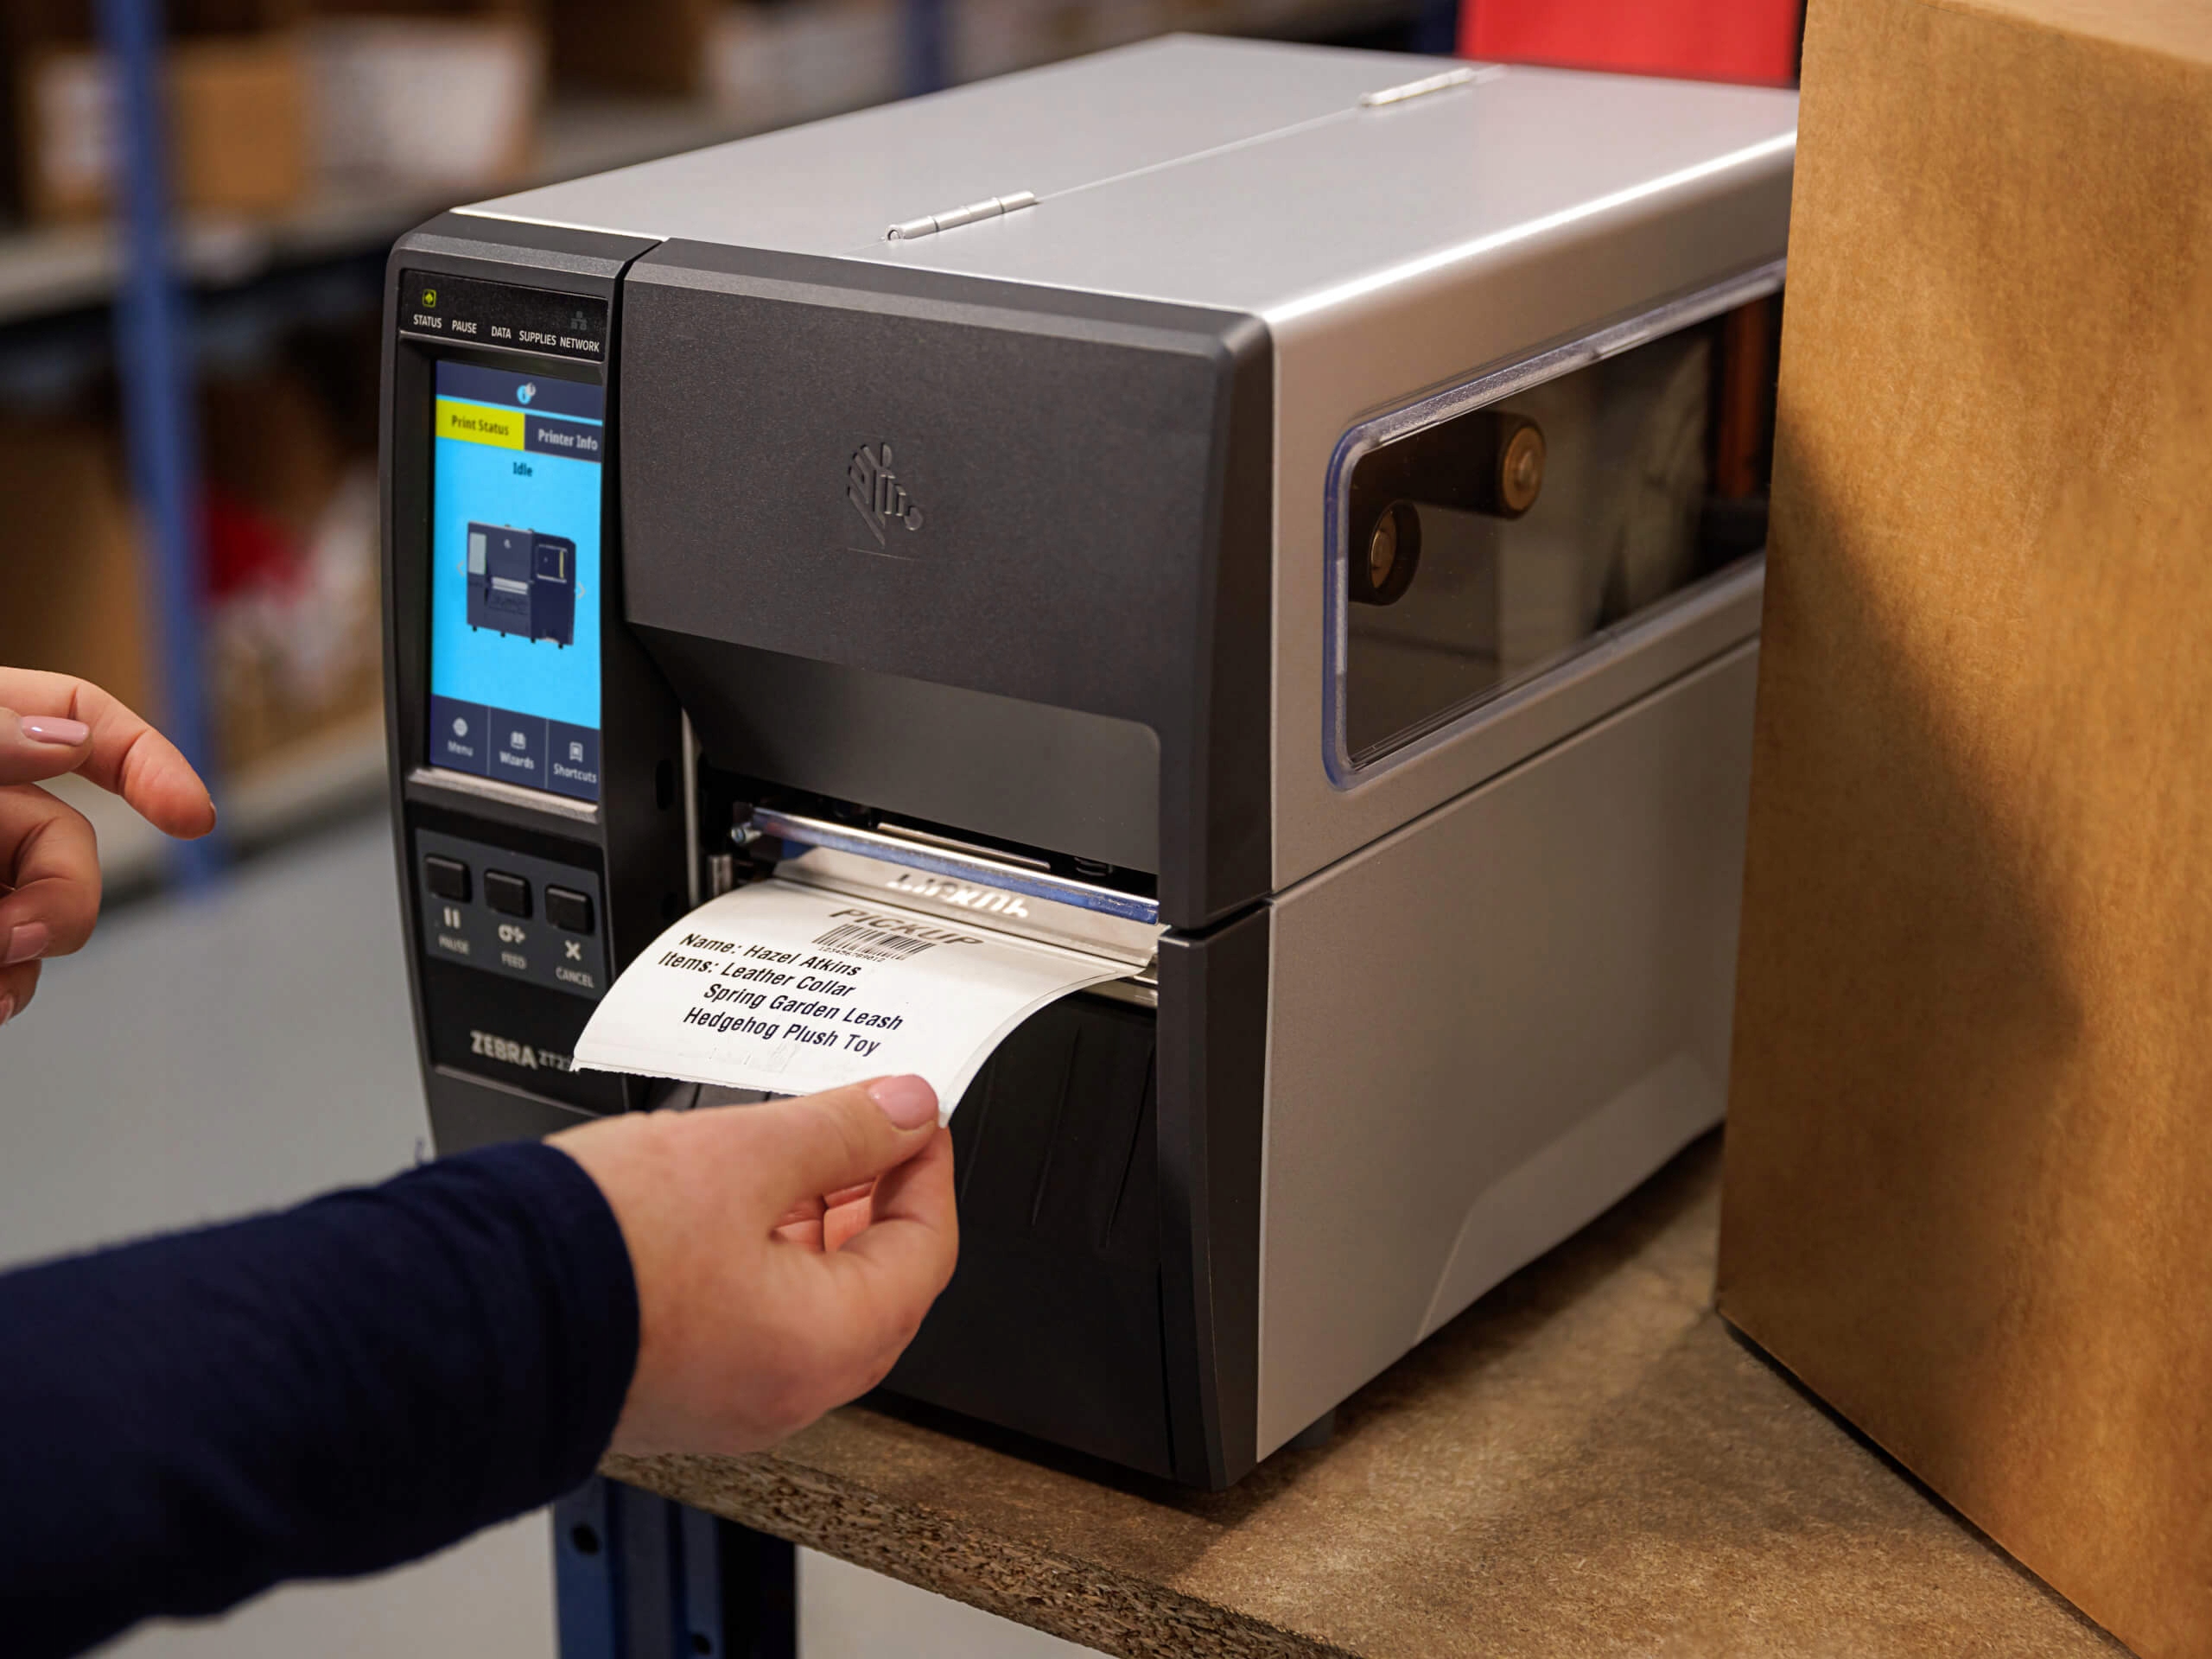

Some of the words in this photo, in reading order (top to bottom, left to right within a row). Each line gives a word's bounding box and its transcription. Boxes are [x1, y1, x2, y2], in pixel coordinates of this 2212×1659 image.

[413, 314, 442, 329] STATUS
[451, 319, 478, 334] PAUSE
[491, 326, 512, 339] DATA
[519, 330, 557, 346] SUPPLIES
[560, 336, 600, 353] NETWORK
[451, 415, 477, 431] Print
[479, 419, 509, 436] Status
[538, 429, 574, 447] Printer
[576, 435, 599, 450] Info
[513, 462, 533, 477] Idle
[448, 741, 474, 757] Menu
[499, 751, 534, 770] Wizards
[553, 763, 597, 784] Shortcuts
[829, 908, 984, 945] PICKUP
[679, 933, 742, 954] Name:
[743, 944, 802, 964] Hazel
[799, 956, 861, 976] Atkins
[556, 967, 594, 988] CANCEL
[658, 951, 719, 973] Items:
[721, 962, 795, 987] Leather
[796, 976, 857, 997] Collar
[703, 983, 767, 1009] Spring
[769, 995, 841, 1020] Garden
[842, 1007, 904, 1030] Leash
[683, 1007, 780, 1040] Hedgehog
[782, 1023, 839, 1047] Plush
[843, 1033, 881, 1058] Toy
[470, 1030, 537, 1070] ZEBRA
